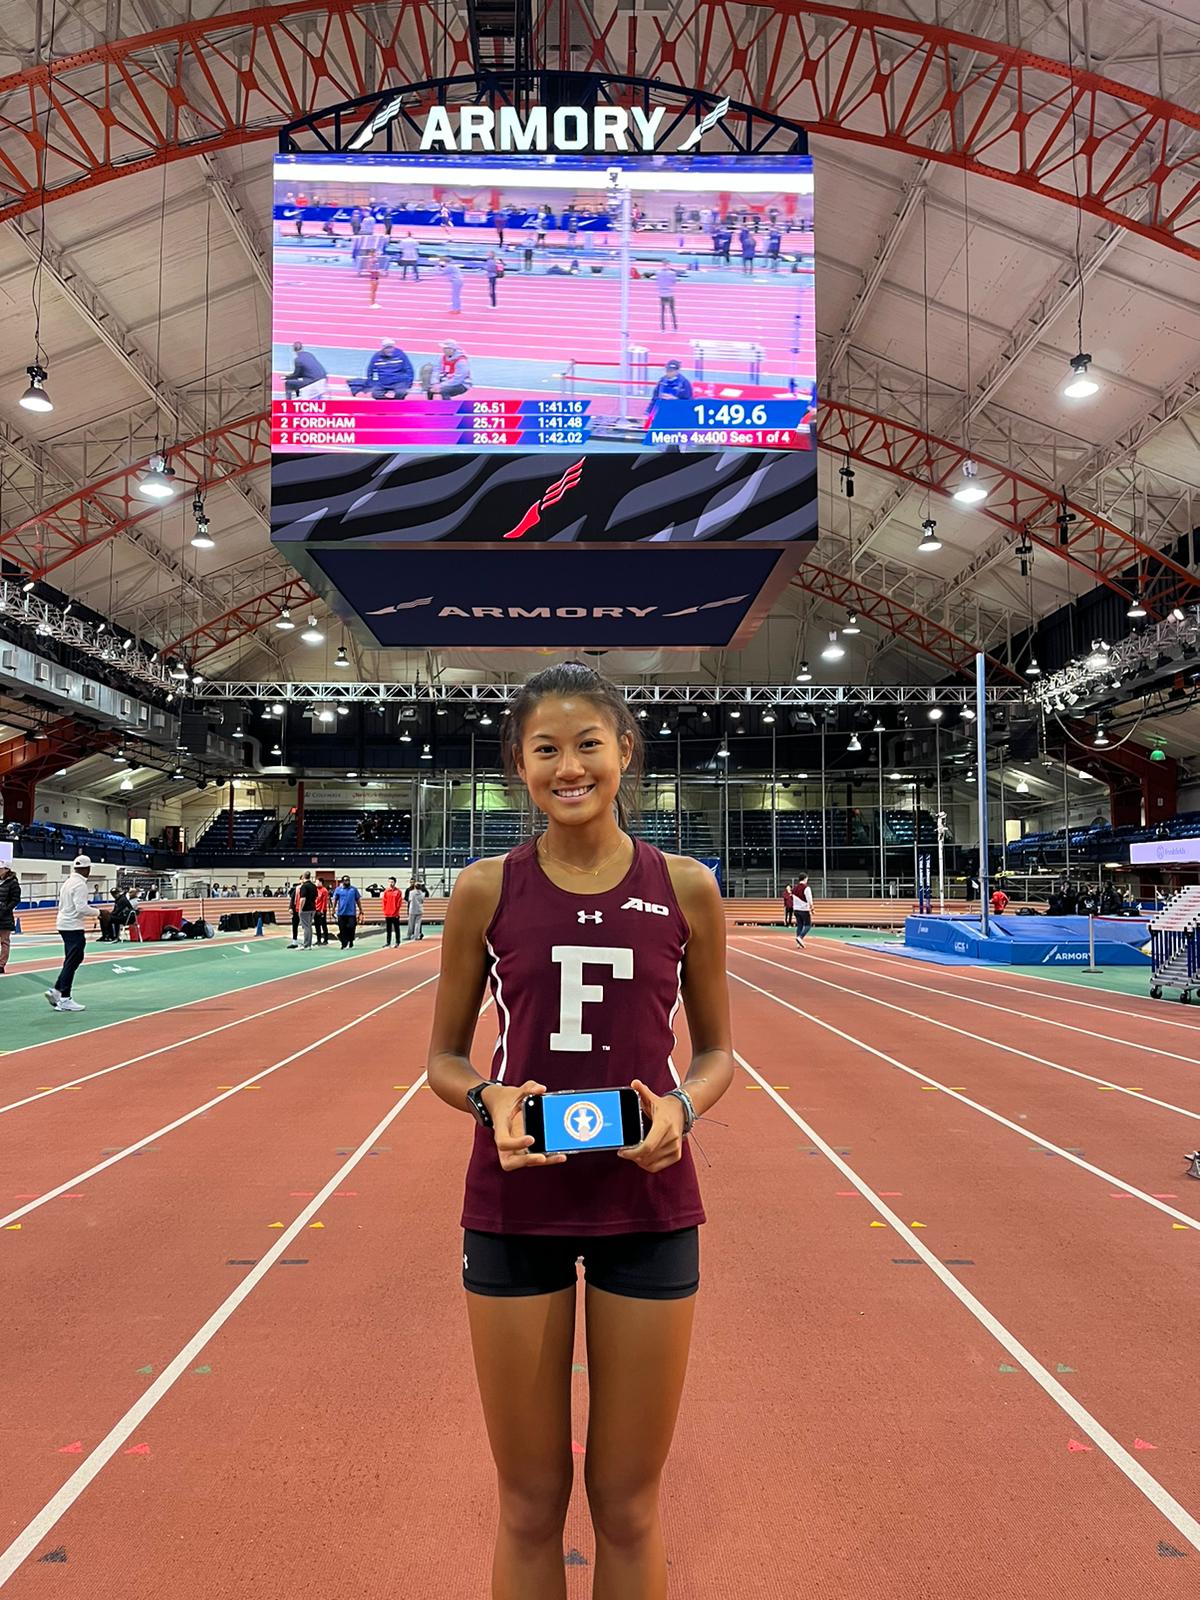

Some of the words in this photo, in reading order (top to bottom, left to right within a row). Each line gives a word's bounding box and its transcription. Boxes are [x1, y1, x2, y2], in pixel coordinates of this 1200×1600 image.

[420, 105, 666, 151] ARMORY
[281, 402, 288, 413] 1
[292, 402, 326, 413] TCNJ
[473, 402, 505, 413] 26.51
[538, 402, 582, 413] 1:41.16
[694, 404, 767, 425] 1:49.6
[280, 417, 288, 428] 2
[292, 417, 355, 428] FORDHAM
[473, 417, 505, 428] 25.71
[538, 417, 582, 428] 1:41.48
[280, 432, 288, 444] 2
[292, 432, 355, 444] FORDHAM
[473, 432, 507, 444] 26.24
[538, 432, 582, 444] 1:42.02
[651, 431, 688, 444] Men's
[690, 431, 727, 444] 4x400
[729, 431, 754, 444] Sec
[756, 431, 763, 443] 1
[767, 431, 780, 443] of
[782, 431, 791, 443] 4
[438, 605, 658, 618] ARMORY
[549, 945, 634, 1052] F
